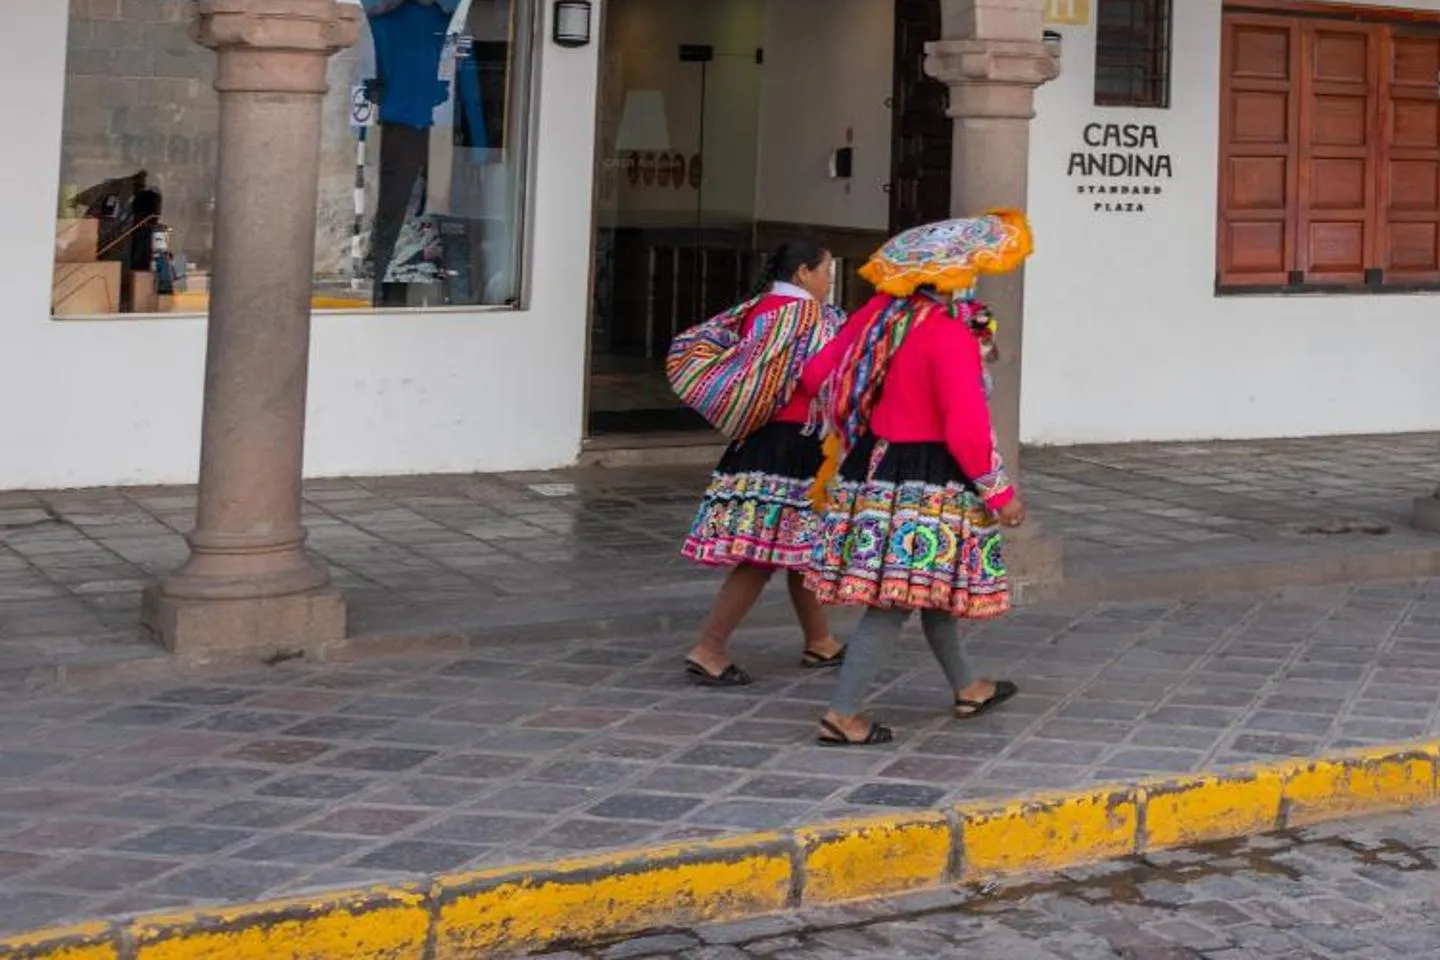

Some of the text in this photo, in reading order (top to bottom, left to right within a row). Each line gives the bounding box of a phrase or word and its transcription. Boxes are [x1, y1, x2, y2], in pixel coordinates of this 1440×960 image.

[1083, 122, 1158, 148] CASA
[1067, 151, 1172, 177] ANDINA
[1077, 185, 1162, 194] STANDARD
[1094, 202, 1143, 213] PLAZA
